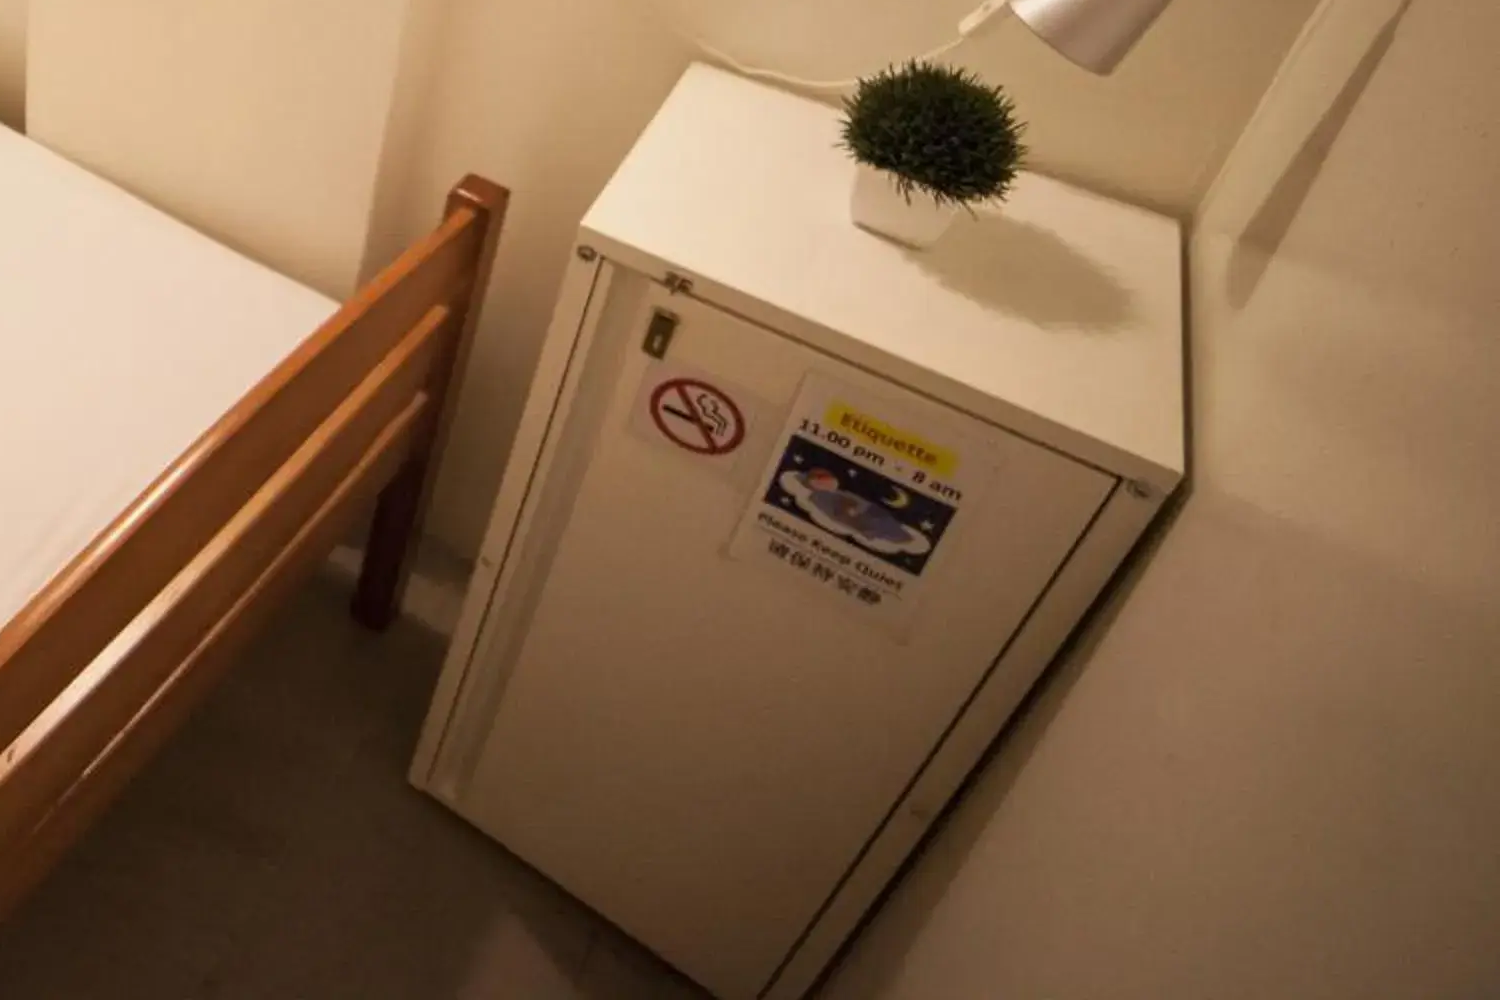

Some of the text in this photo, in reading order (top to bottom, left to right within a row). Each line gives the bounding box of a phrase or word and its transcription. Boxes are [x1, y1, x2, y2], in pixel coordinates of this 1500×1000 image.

[800, 418, 850, 448] 11.00
[853, 445, 885, 466] pm
[912, 470, 926, 484] 8
[929, 479, 962, 501] am
[841, 411, 937, 464] Etiquette
[758, 512, 904, 590] Please Keep Quiet
